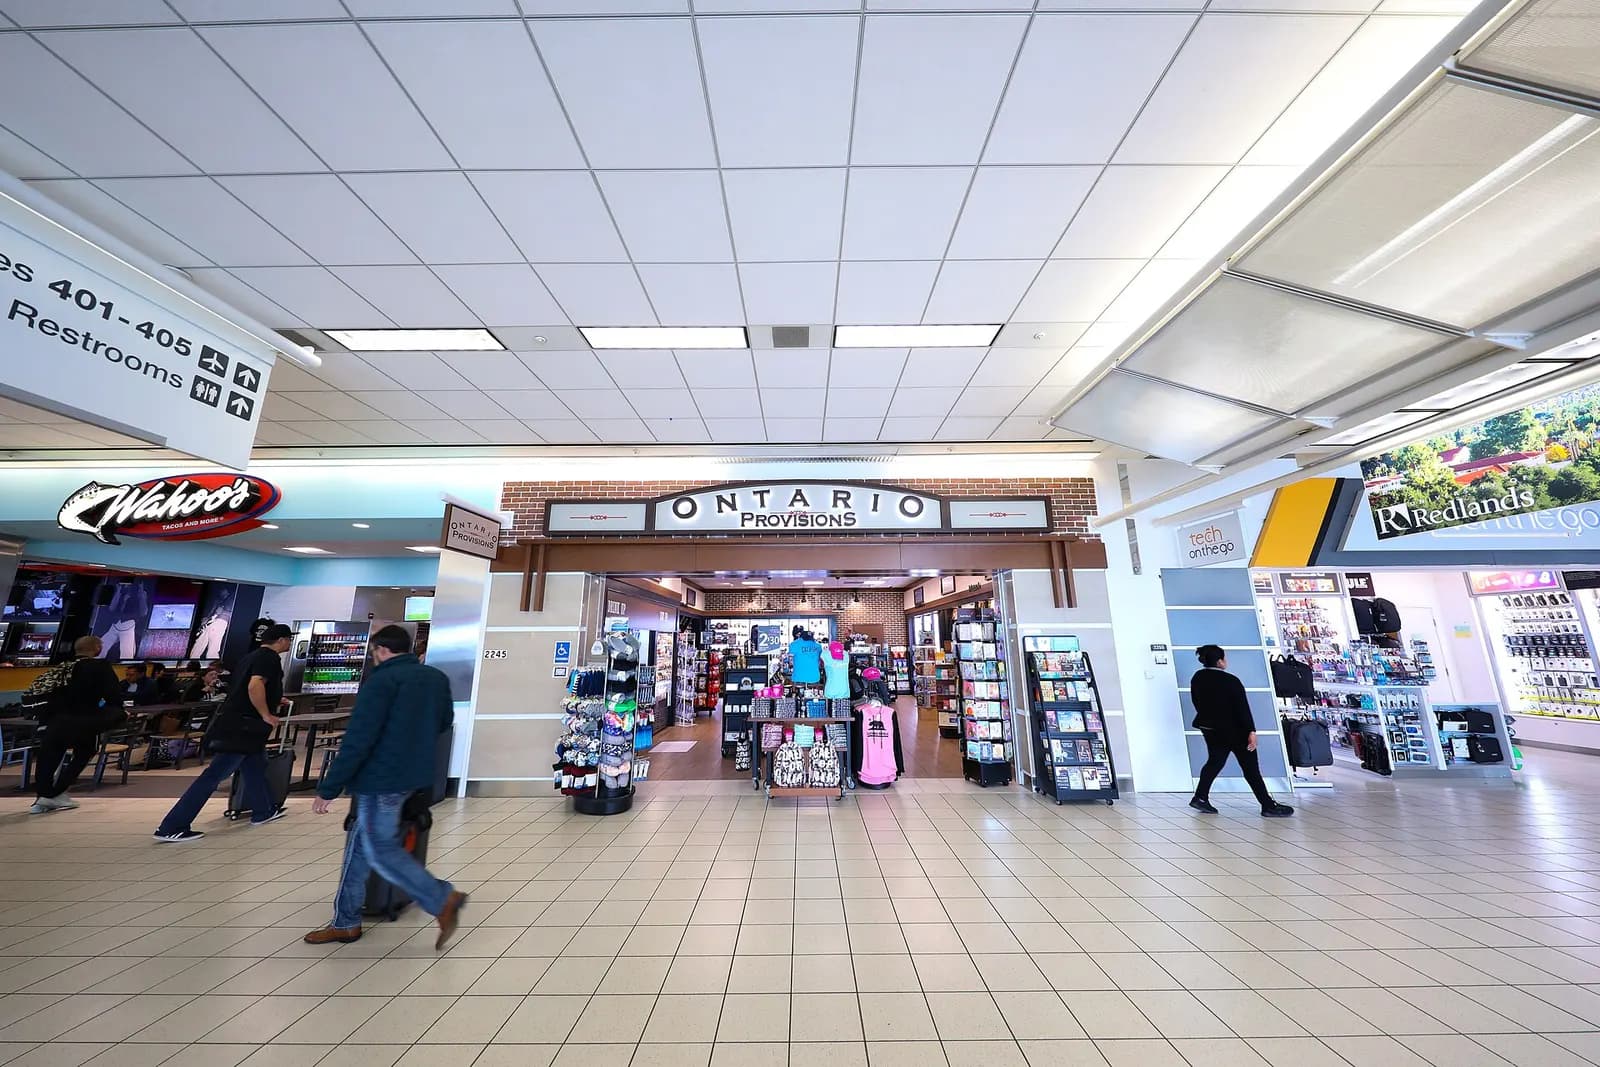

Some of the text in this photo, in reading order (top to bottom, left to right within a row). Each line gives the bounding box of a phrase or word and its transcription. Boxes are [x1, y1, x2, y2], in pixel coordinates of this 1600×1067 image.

[7, 298, 184, 389] Restrooms
[100, 477, 250, 525] Wahoo's
[672, 488, 924, 520] ONTARIO
[1411, 486, 1535, 528] Redlands
[161, 522, 184, 531] TACOS
[184, 519, 199, 528] AND
[450, 521, 498, 543] ONTARIO
[1189, 525, 1223, 546] tech
[484, 650, 507, 659] 2245
